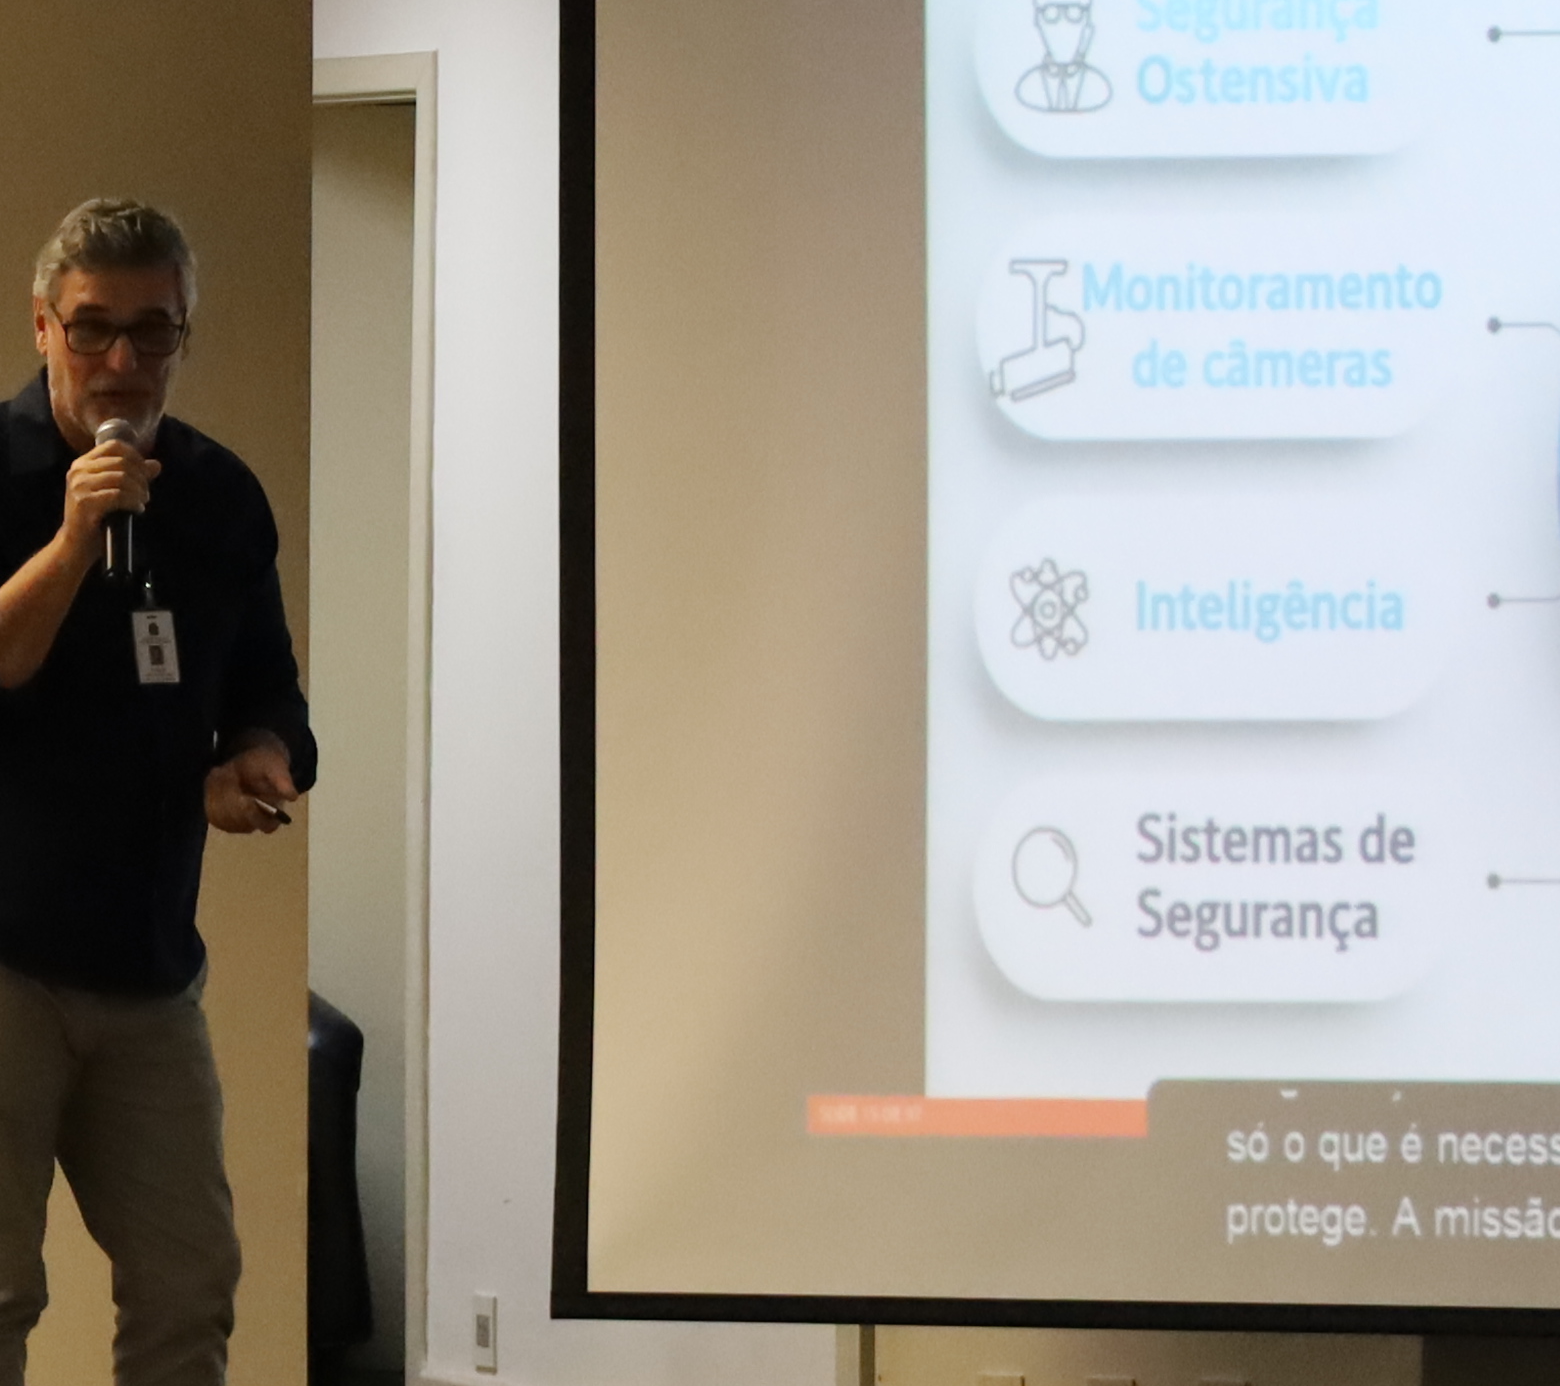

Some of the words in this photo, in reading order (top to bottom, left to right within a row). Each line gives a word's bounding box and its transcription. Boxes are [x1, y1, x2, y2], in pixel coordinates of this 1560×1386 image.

[1136, 53, 1370, 106] Ostensiva
[1082, 262, 1443, 313] Monitoramento
[1132, 340, 1189, 389] de
[1202, 340, 1395, 388] câmeras
[1136, 579, 1406, 643] Inteligência
[1137, 812, 1344, 864] Sistemas
[1358, 813, 1416, 865] de
[1137, 887, 1379, 953] Segurança
[1227, 1123, 1270, 1162] só
[1283, 1131, 1306, 1162] o
[1317, 1131, 1389, 1171] que
[1399, 1124, 1423, 1163] é
[1227, 1198, 1377, 1247] protege.
[1392, 1197, 1422, 1235] A
